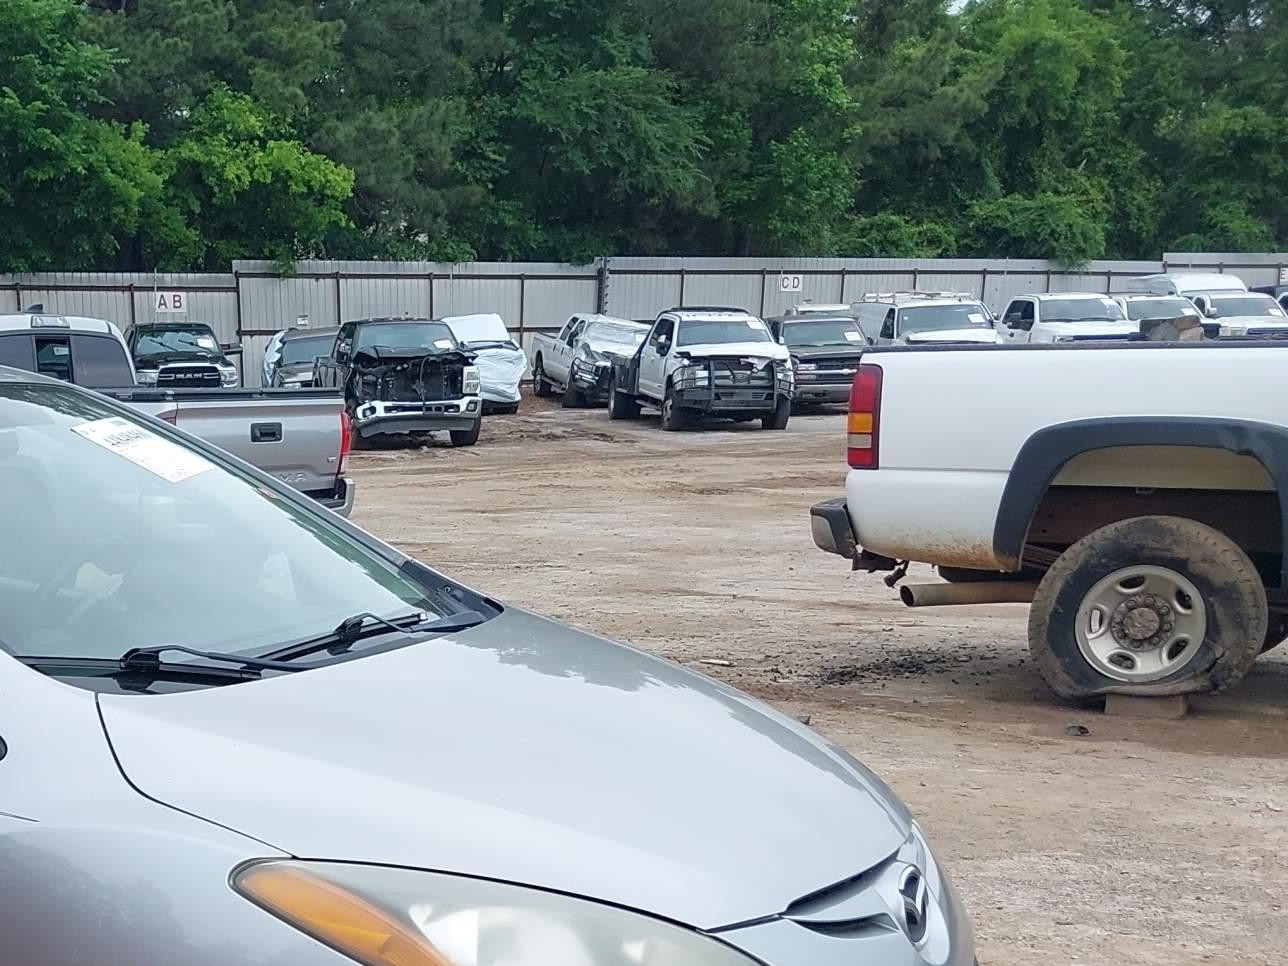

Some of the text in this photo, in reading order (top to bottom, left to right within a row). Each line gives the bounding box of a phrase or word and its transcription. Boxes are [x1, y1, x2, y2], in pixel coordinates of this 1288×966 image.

[782, 276, 800, 289] C D
[158, 294, 182, 309] A B
